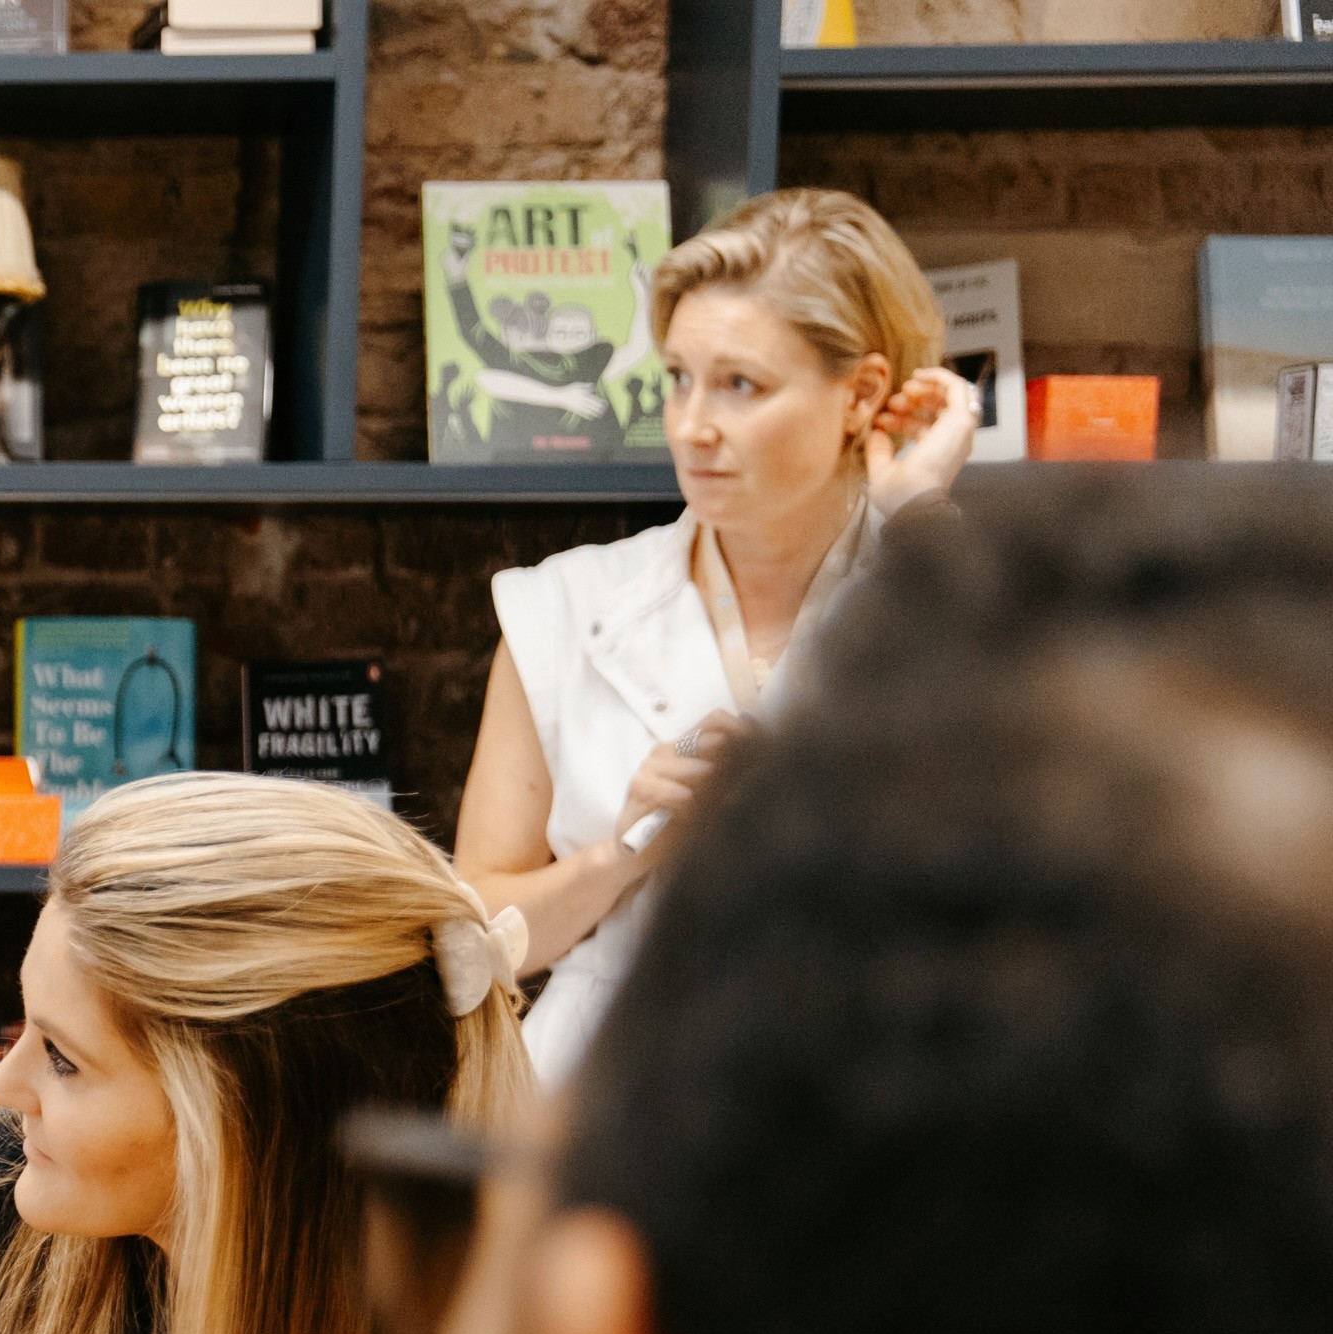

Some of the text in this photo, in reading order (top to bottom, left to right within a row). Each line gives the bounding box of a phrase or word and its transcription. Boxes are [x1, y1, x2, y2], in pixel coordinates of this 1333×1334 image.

[487, 204, 590, 246] ART
[484, 250, 611, 277] PROTEST
[177, 298, 232, 321] Why
[175, 319, 234, 338] have
[156, 352, 250, 377] been no
[34, 663, 104, 688] What
[31, 694, 115, 718] Seems
[262, 693, 374, 731] WHITE
[34, 718, 108, 747] To Be
[257, 729, 382, 760] FRAGILITY
